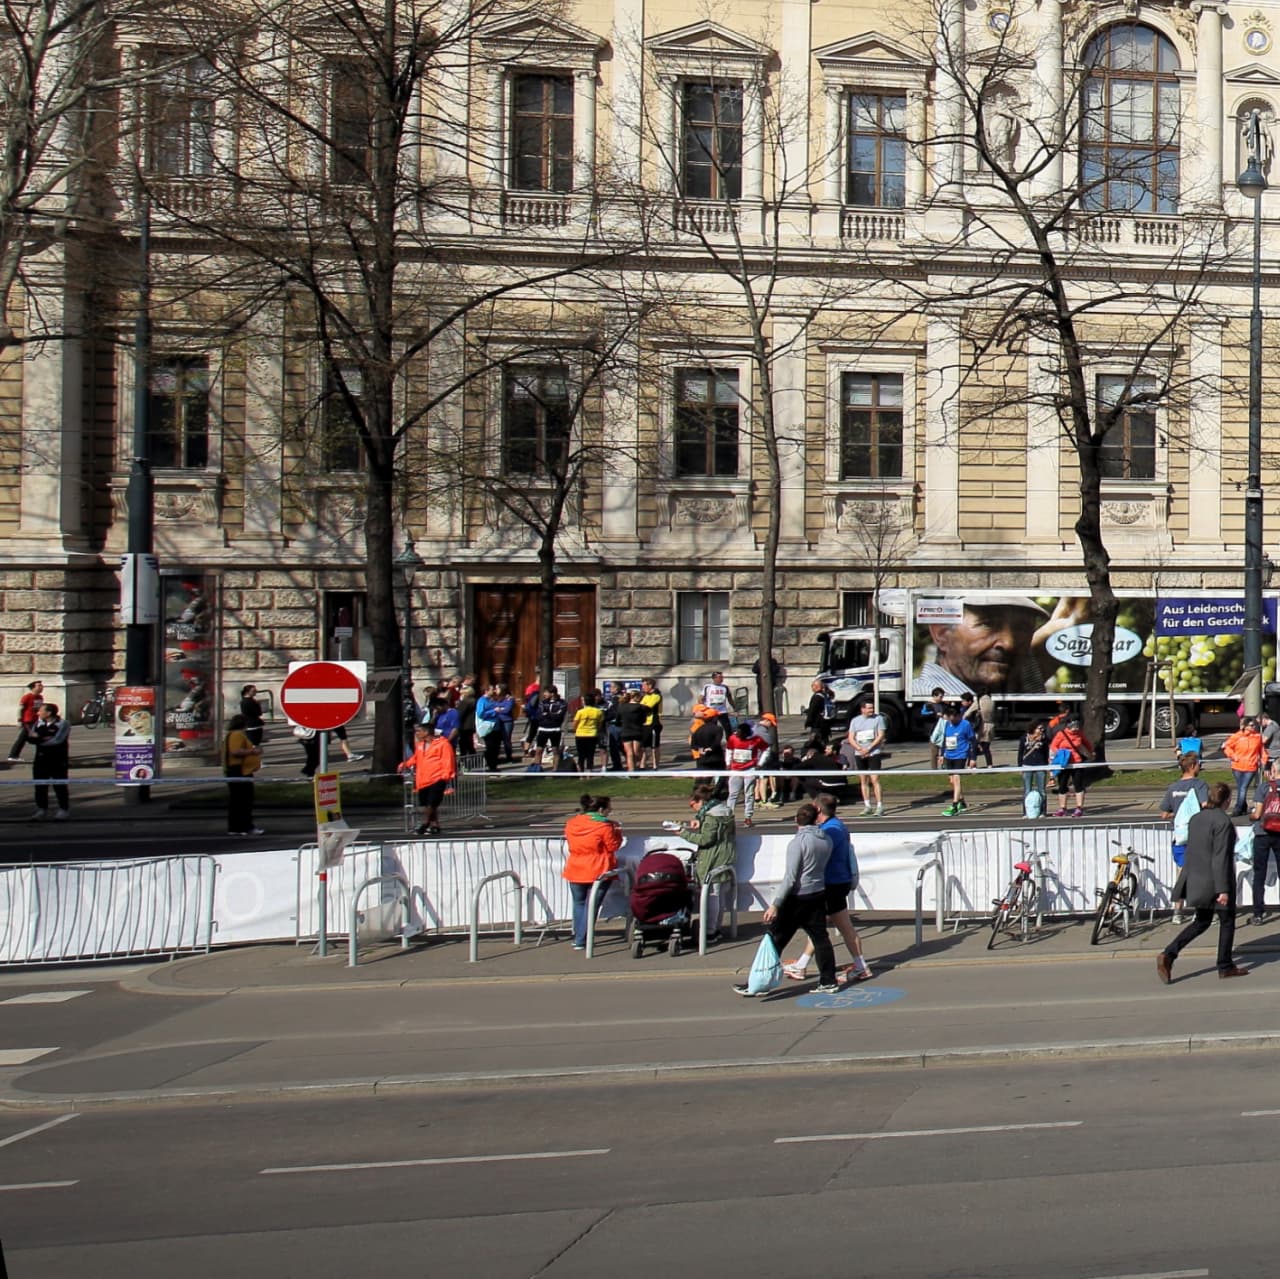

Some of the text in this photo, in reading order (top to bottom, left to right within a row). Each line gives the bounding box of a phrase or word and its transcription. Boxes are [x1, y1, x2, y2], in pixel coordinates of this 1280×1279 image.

[1163, 605, 1184, 614] Aus
[1163, 618, 1180, 628] für
[1183, 618, 1204, 628] den
[1055, 634, 1135, 658] Sanar
